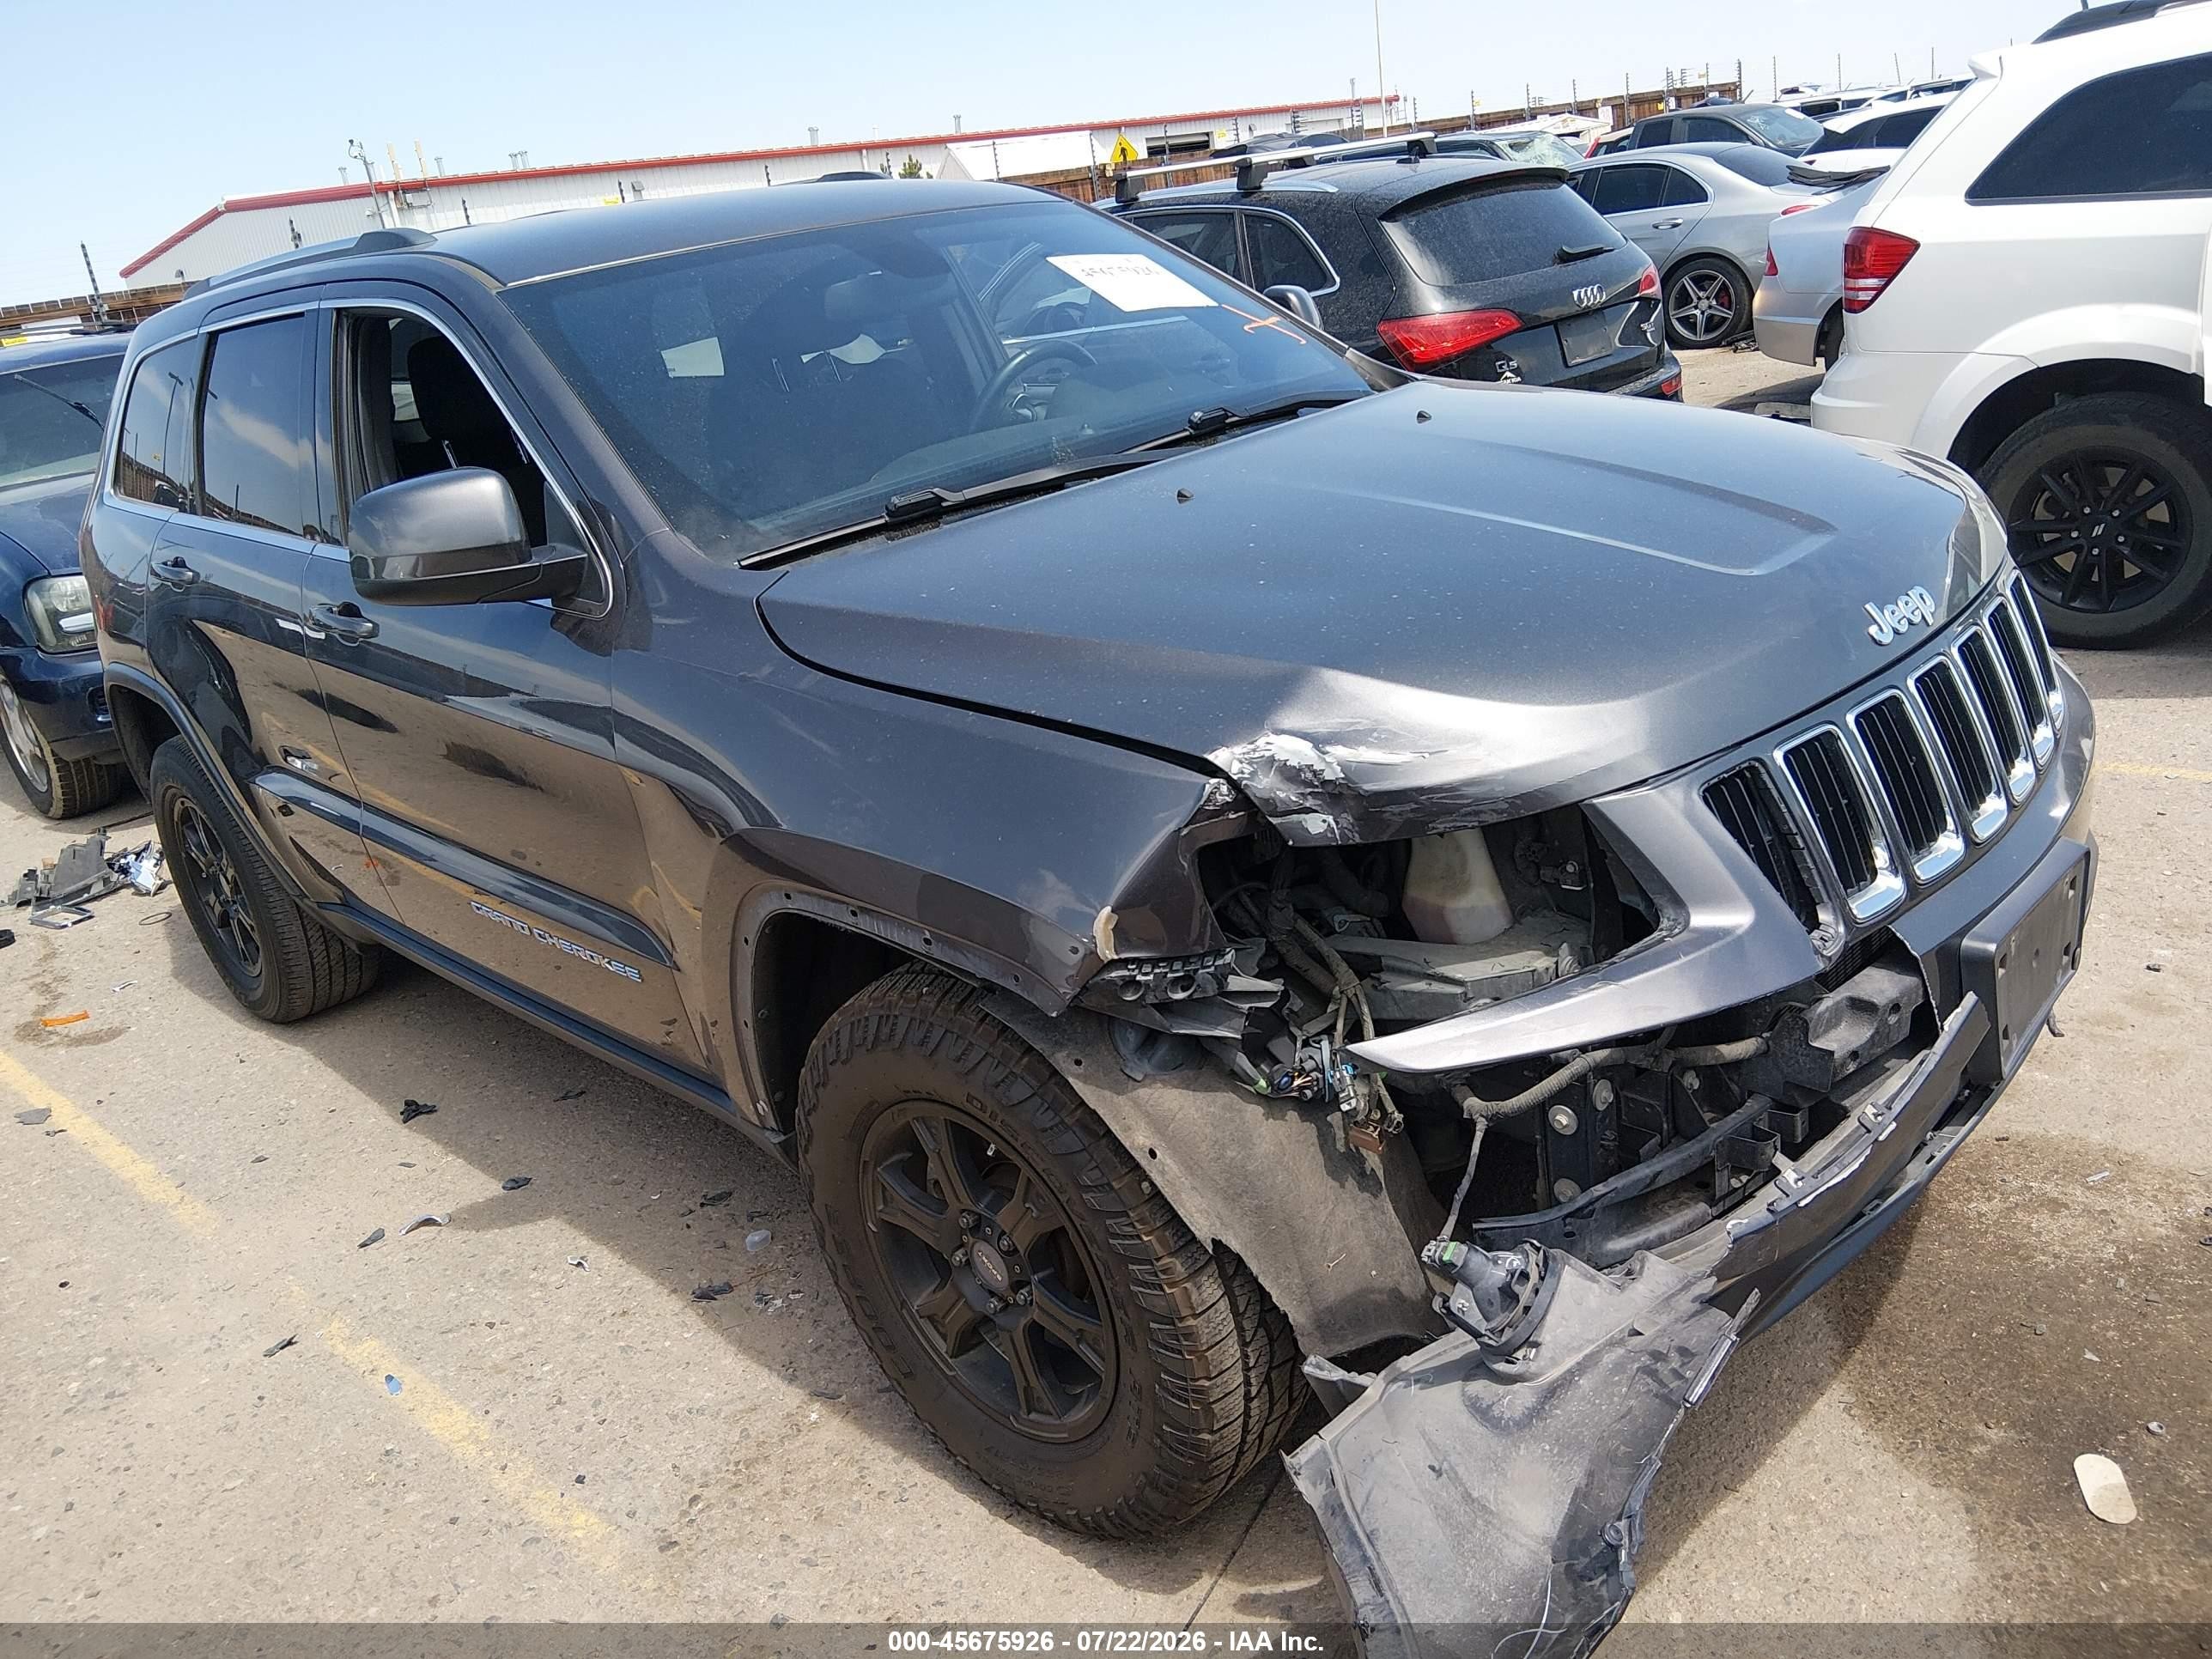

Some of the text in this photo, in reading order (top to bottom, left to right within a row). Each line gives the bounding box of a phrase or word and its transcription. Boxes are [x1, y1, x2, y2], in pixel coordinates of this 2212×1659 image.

[1495, 360, 1518, 373] Q5
[1862, 585, 1936, 647] Jeep
[532, 927, 643, 983] CHEROKEE
[823, 1202, 915, 1381] COOPER
[977, 1250, 1003, 1281] SPORT
